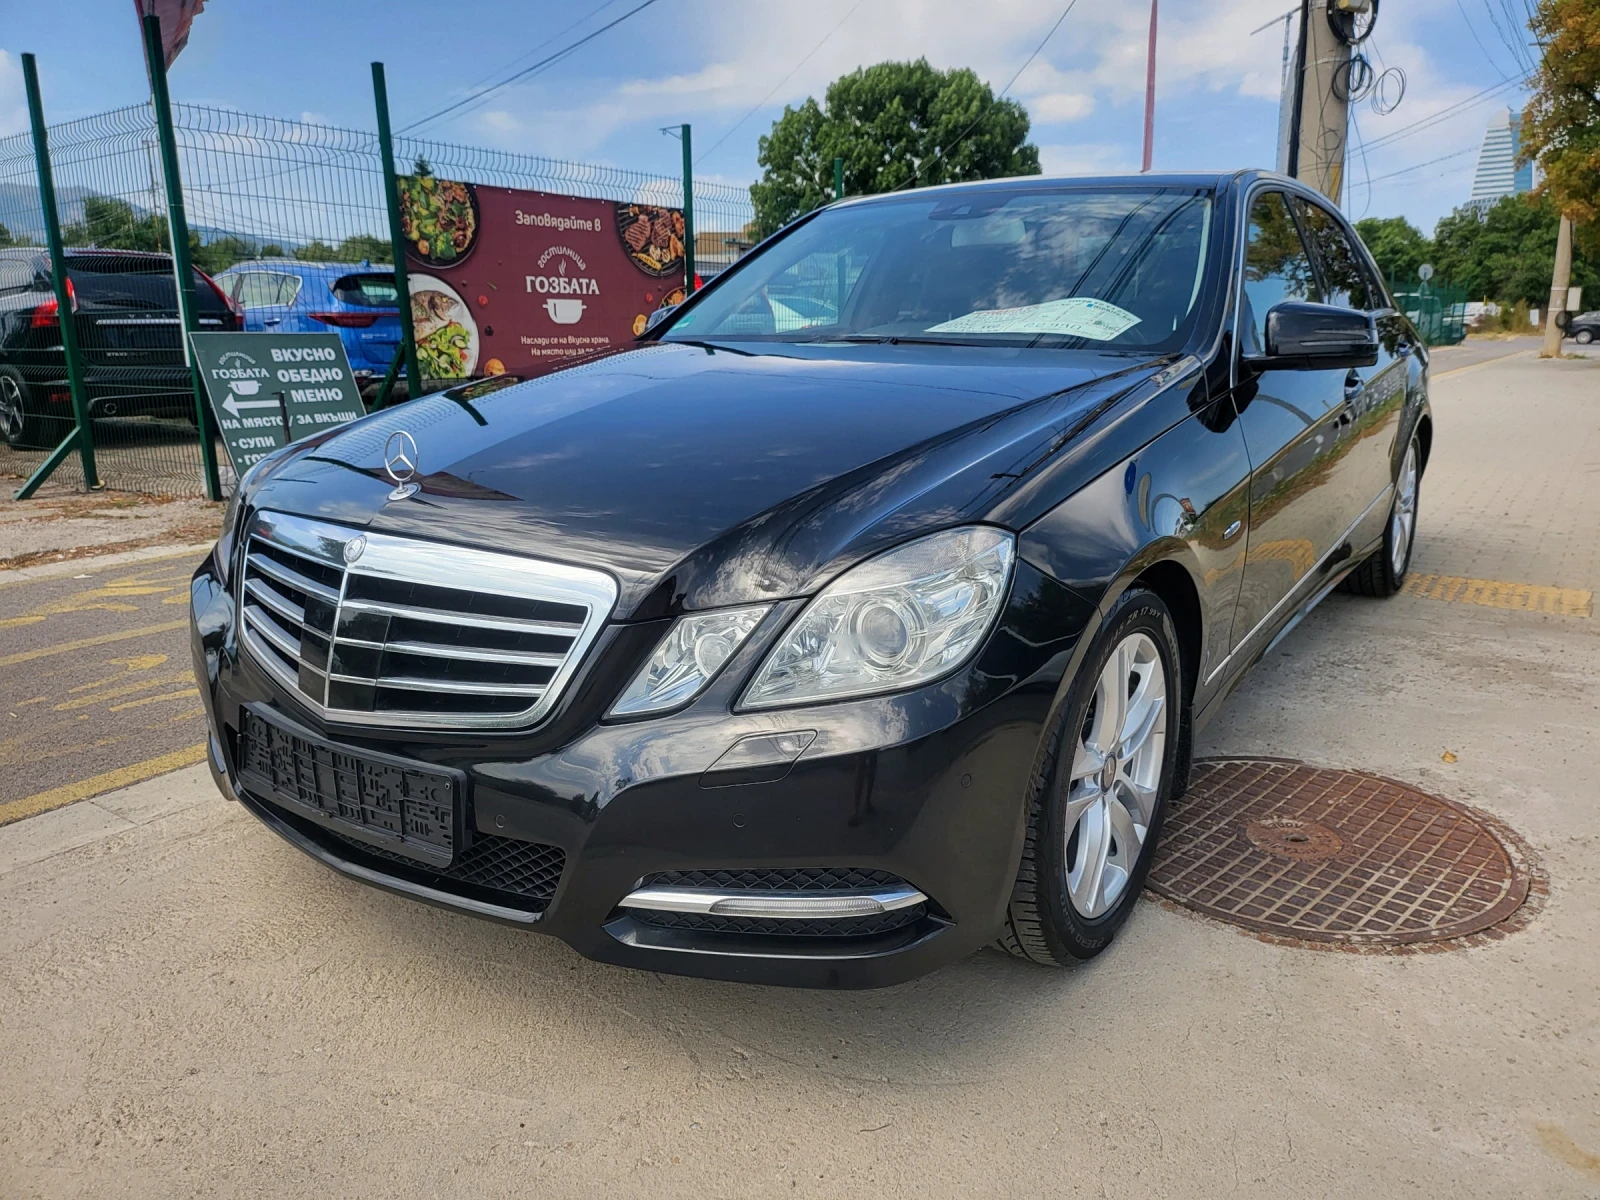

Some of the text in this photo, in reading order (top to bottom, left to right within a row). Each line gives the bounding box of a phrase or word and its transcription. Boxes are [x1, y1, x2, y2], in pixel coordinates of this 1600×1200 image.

[515, 210, 593, 231] Заповядайте
[537, 245, 587, 271] гостилница
[525, 275, 600, 295] ГОЗБАТА
[520, 335, 550, 347] Наслади
[550, 337, 558, 345] се
[559, 337, 568, 345] на
[270, 347, 337, 363] ВКУСНО
[531, 347, 541, 356] На
[541, 347, 564, 356] място
[211, 367, 271, 380] ГОЗБАТА
[276, 367, 344, 384] ОБЕДНО
[290, 387, 344, 403] МЕНЮ
[222, 419, 241, 430] НА
[296, 414, 313, 425] ЗА
[314, 411, 358, 424] ВКЪЩИ
[238, 435, 276, 449] СУПИ
[1140, 606, 1149, 616] 17
